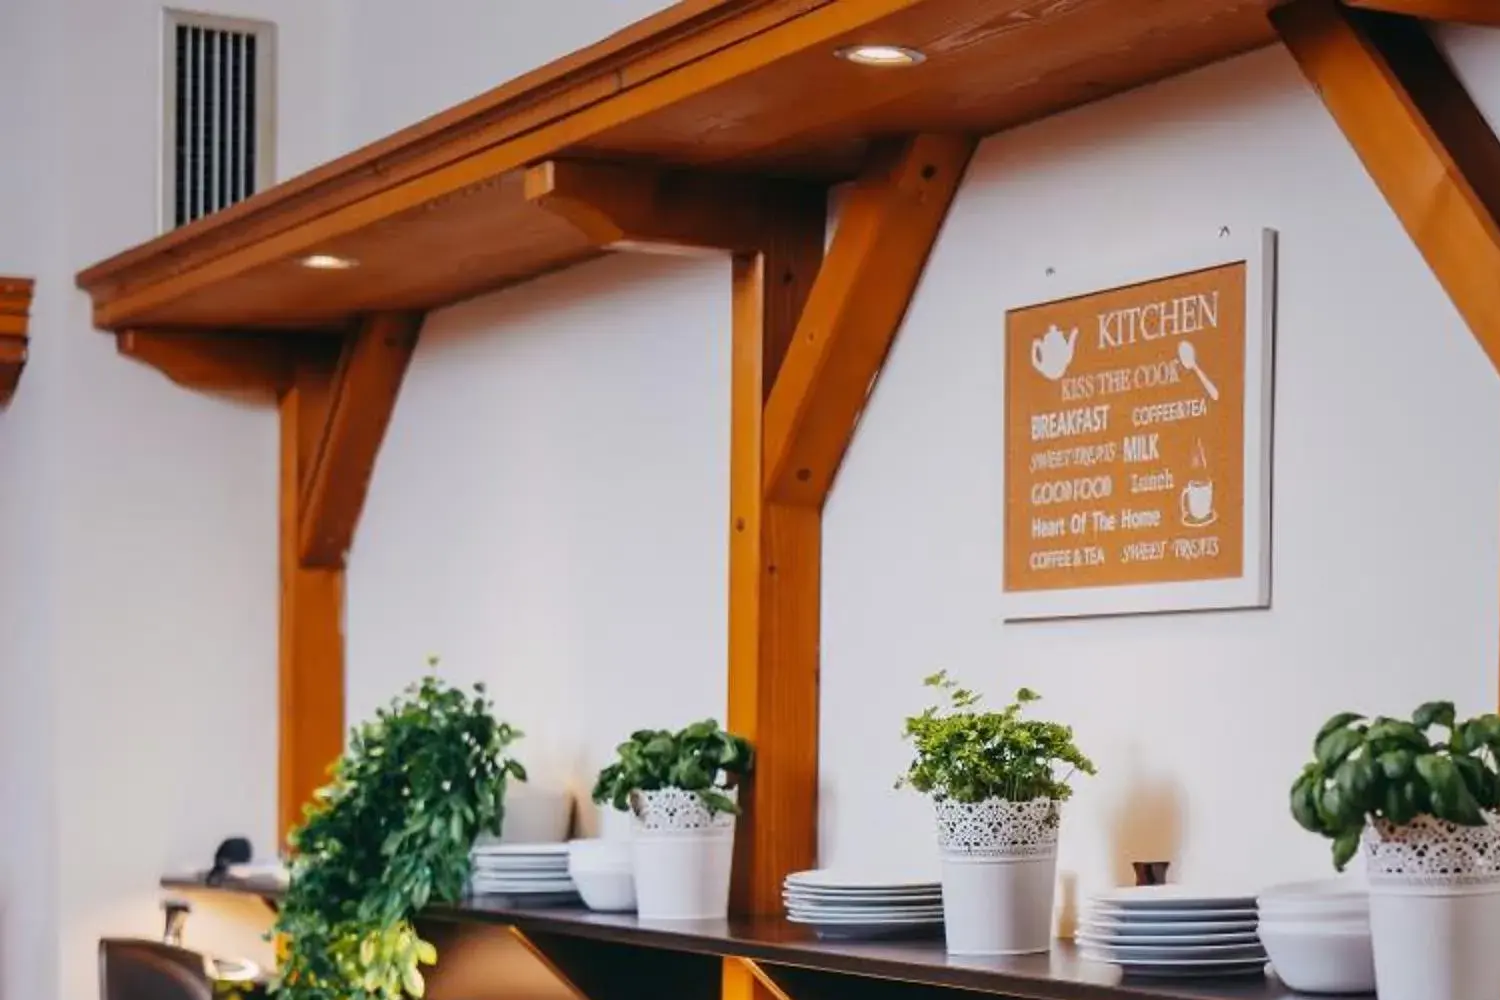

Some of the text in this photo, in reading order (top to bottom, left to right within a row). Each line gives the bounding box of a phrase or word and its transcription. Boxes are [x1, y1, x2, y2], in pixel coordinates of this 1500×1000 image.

[1097, 290, 1219, 349] KITCHEN
[1061, 358, 1182, 401] KISS THE COOK
[1031, 404, 1111, 440] BREAKFAST
[1123, 433, 1159, 463] MILK
[1130, 468, 1175, 494] Lunch
[1031, 508, 1162, 539] Heart Of The Home
